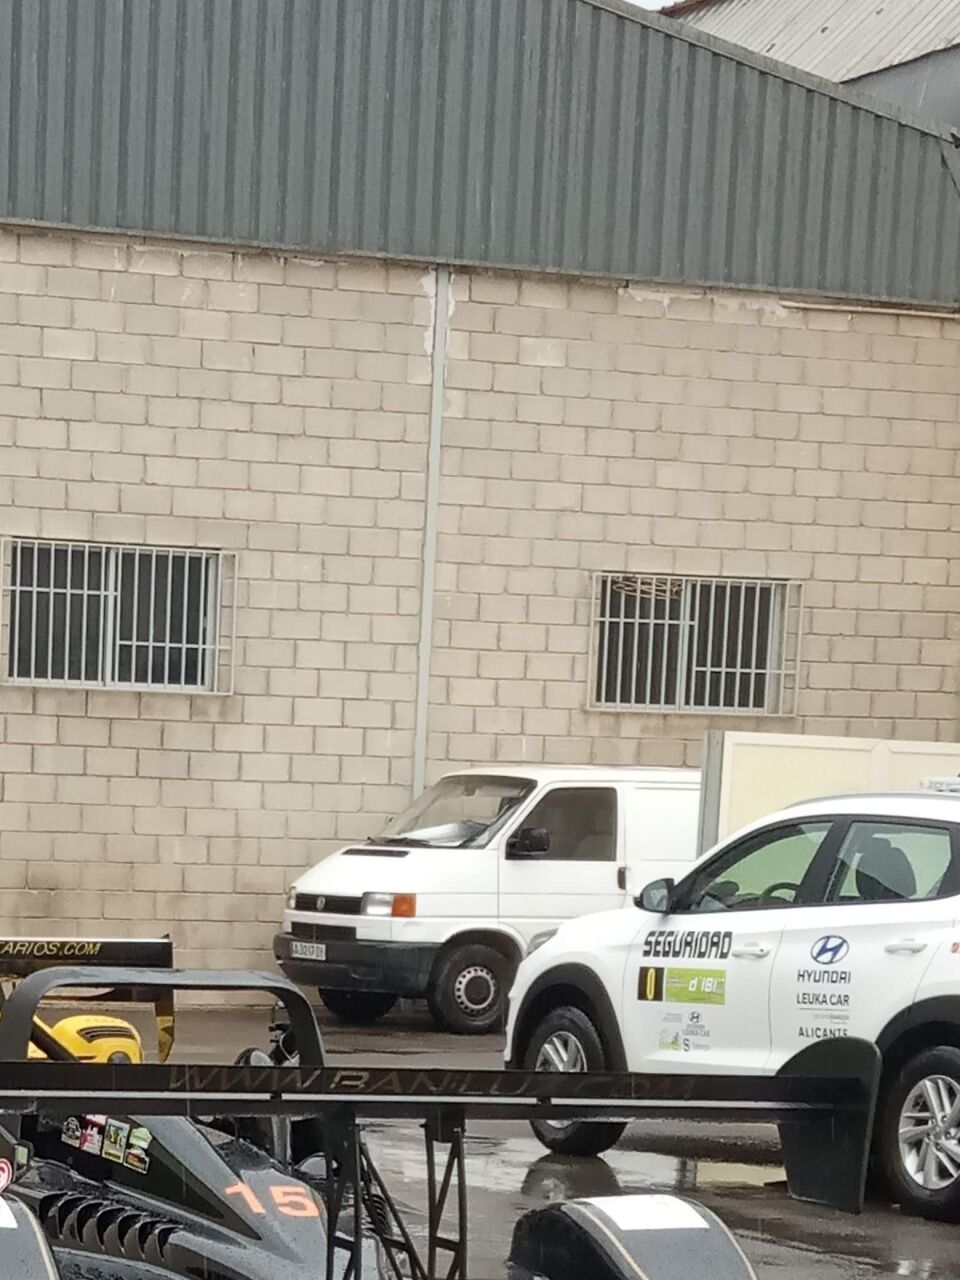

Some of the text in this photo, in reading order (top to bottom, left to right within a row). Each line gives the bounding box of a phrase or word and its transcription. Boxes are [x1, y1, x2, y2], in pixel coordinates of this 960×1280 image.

[642, 930, 733, 959] SEGURIDAD
[797, 969, 852, 985] HYUNDAI
[796, 992, 850, 1007] LEUKA CAR
[225, 1180, 321, 1218] 15
